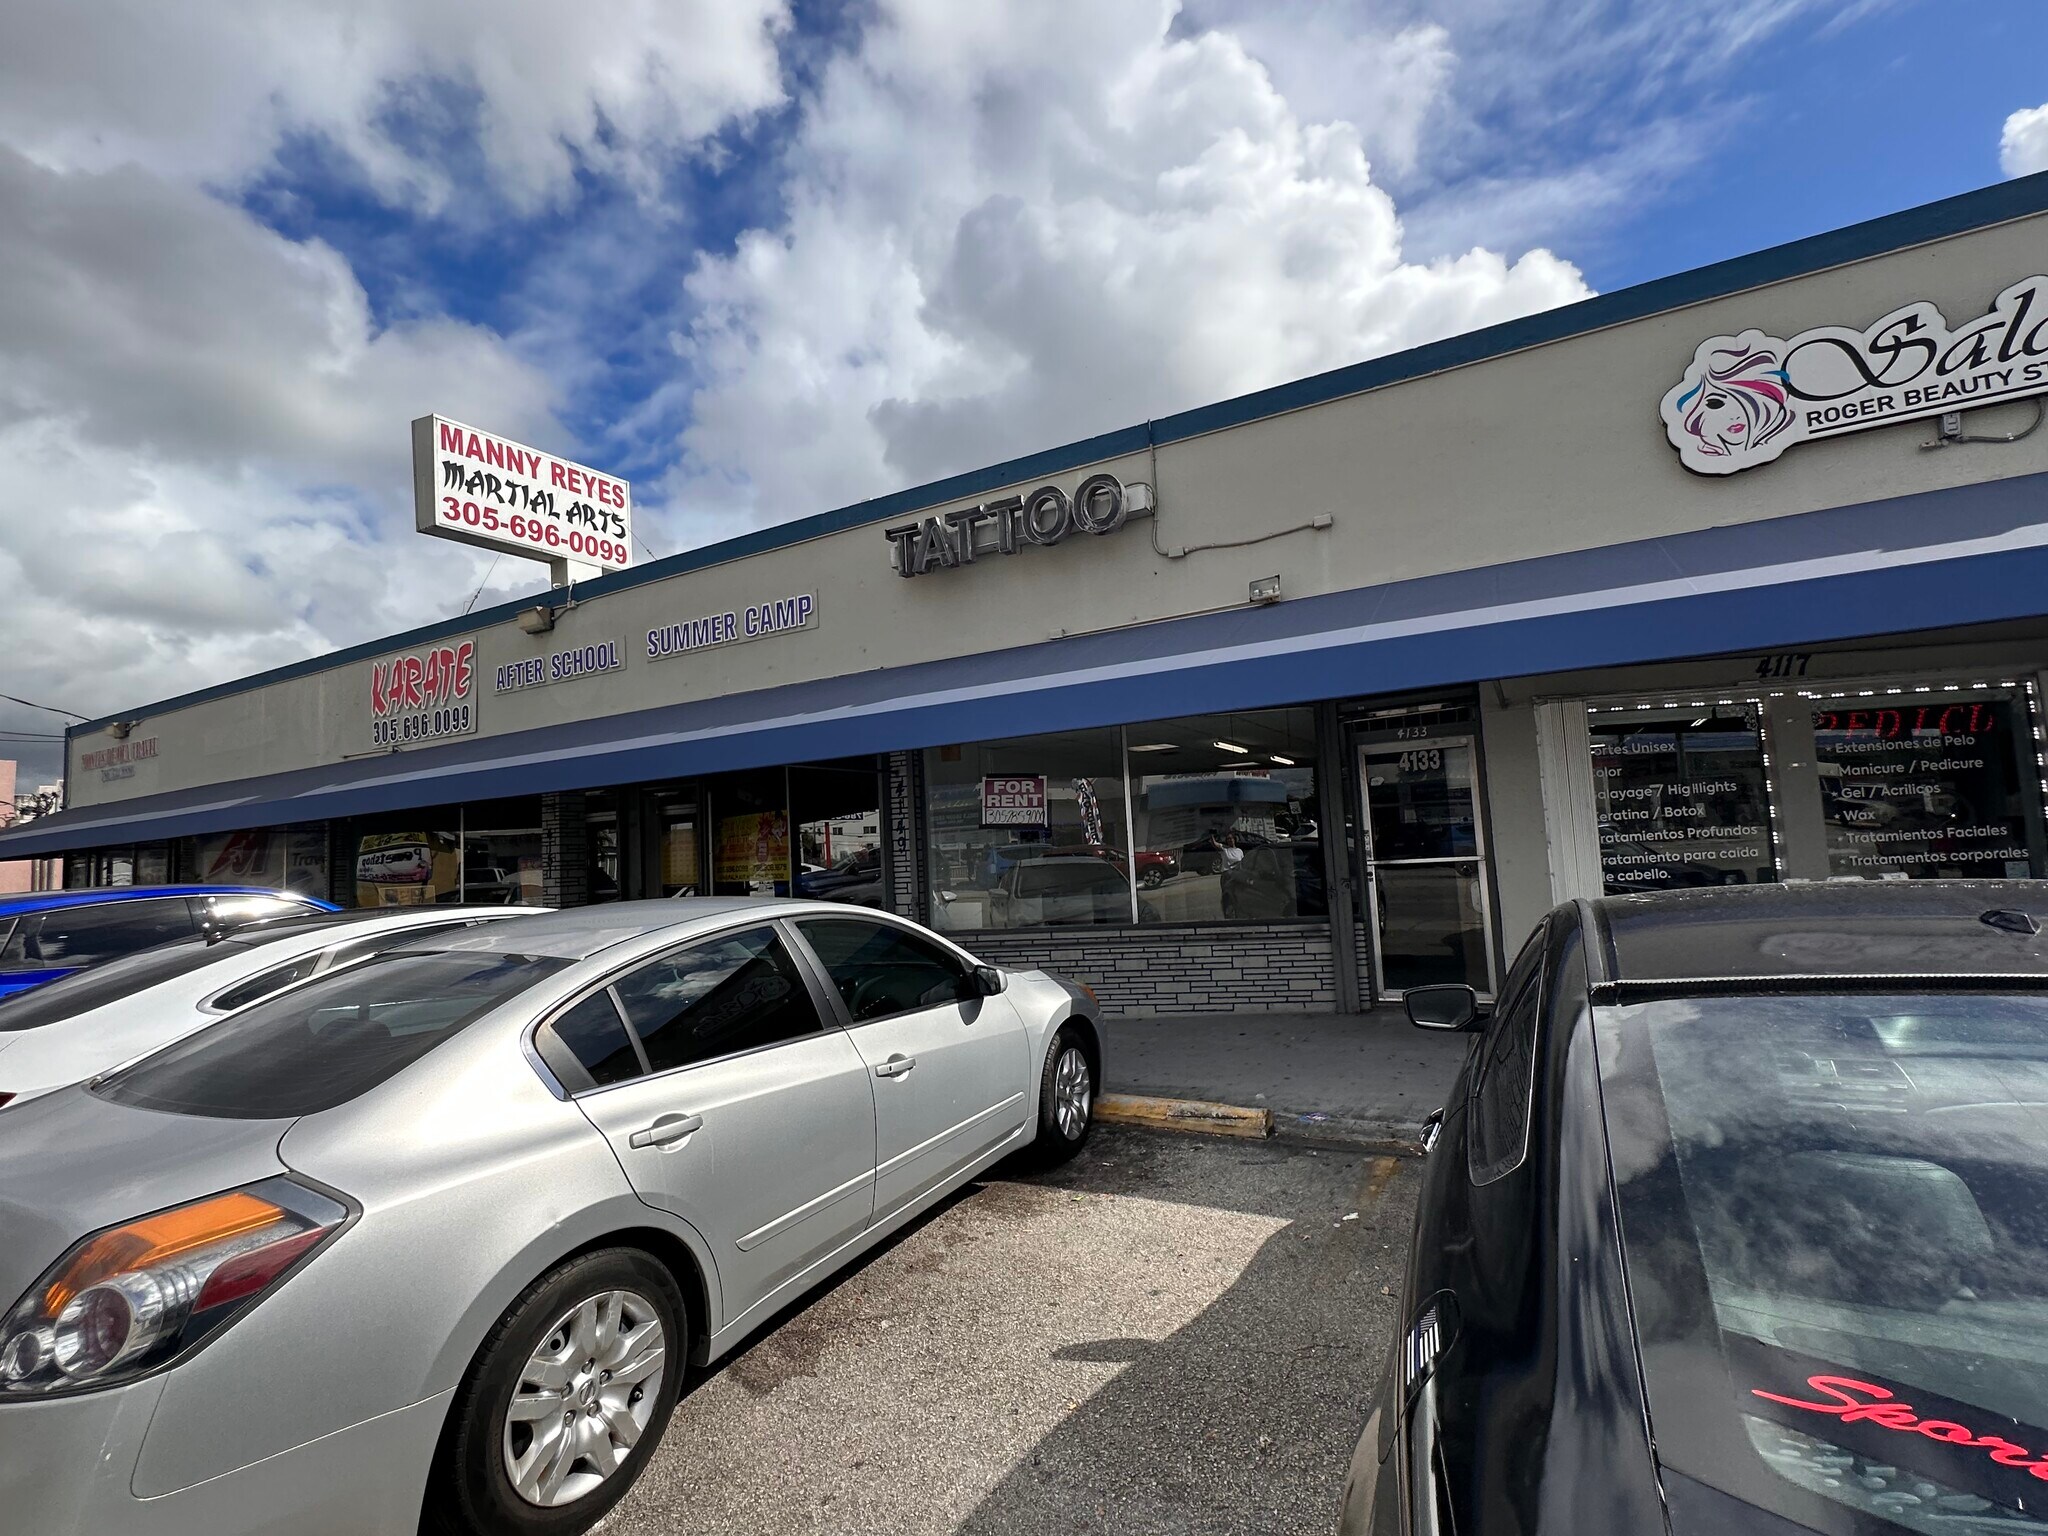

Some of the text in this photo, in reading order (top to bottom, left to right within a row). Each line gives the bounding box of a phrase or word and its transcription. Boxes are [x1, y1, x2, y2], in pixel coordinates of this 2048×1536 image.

[1807, 395, 1895, 427] ROGER
[1904, 368, 2014, 406] BEAUTY
[441, 424, 625, 509] MANNY REYES
[442, 460, 626, 539] MARTIAL ARTS
[443, 496, 627, 564] 305-696-0099
[885, 473, 1128, 578] TATTOO
[646, 594, 813, 658] SUMMER CAMP
[495, 641, 620, 691] AFTER SCHOOL
[1756, 655, 1811, 677] 4117
[371, 641, 474, 716] KARATE
[373, 705, 470, 745] 305.696.0099
[1398, 727, 1427, 738] 4133
[1594, 742, 1676, 757] ortes Unisex
[1835, 734, 1975, 753] Extensiones de Pelo
[1400, 750, 1440, 771] 4133
[1839, 763, 1905, 776] Manicure
[1920, 758, 1984, 771] Pedicure
[1593, 766, 1623, 777] olor
[993, 781, 1035, 793] FOR
[1594, 787, 1653, 801] alayage
[1841, 786, 1865, 798] Gel
[1880, 783, 1941, 796] Acrilicos
[987, 794, 1042, 807] RENT
[1664, 806, 1705, 818] Botox
[1843, 810, 1876, 821] Wax
[1600, 824, 1758, 844] ratamientos Profundos
[1846, 825, 2008, 844] Tratamientos Faciales
[1602, 851, 1680, 866] ratamiento
[1683, 851, 1716, 864] para
[1849, 847, 2029, 866] Tratamientos corporales
[1617, 868, 1671, 881] cabello.
